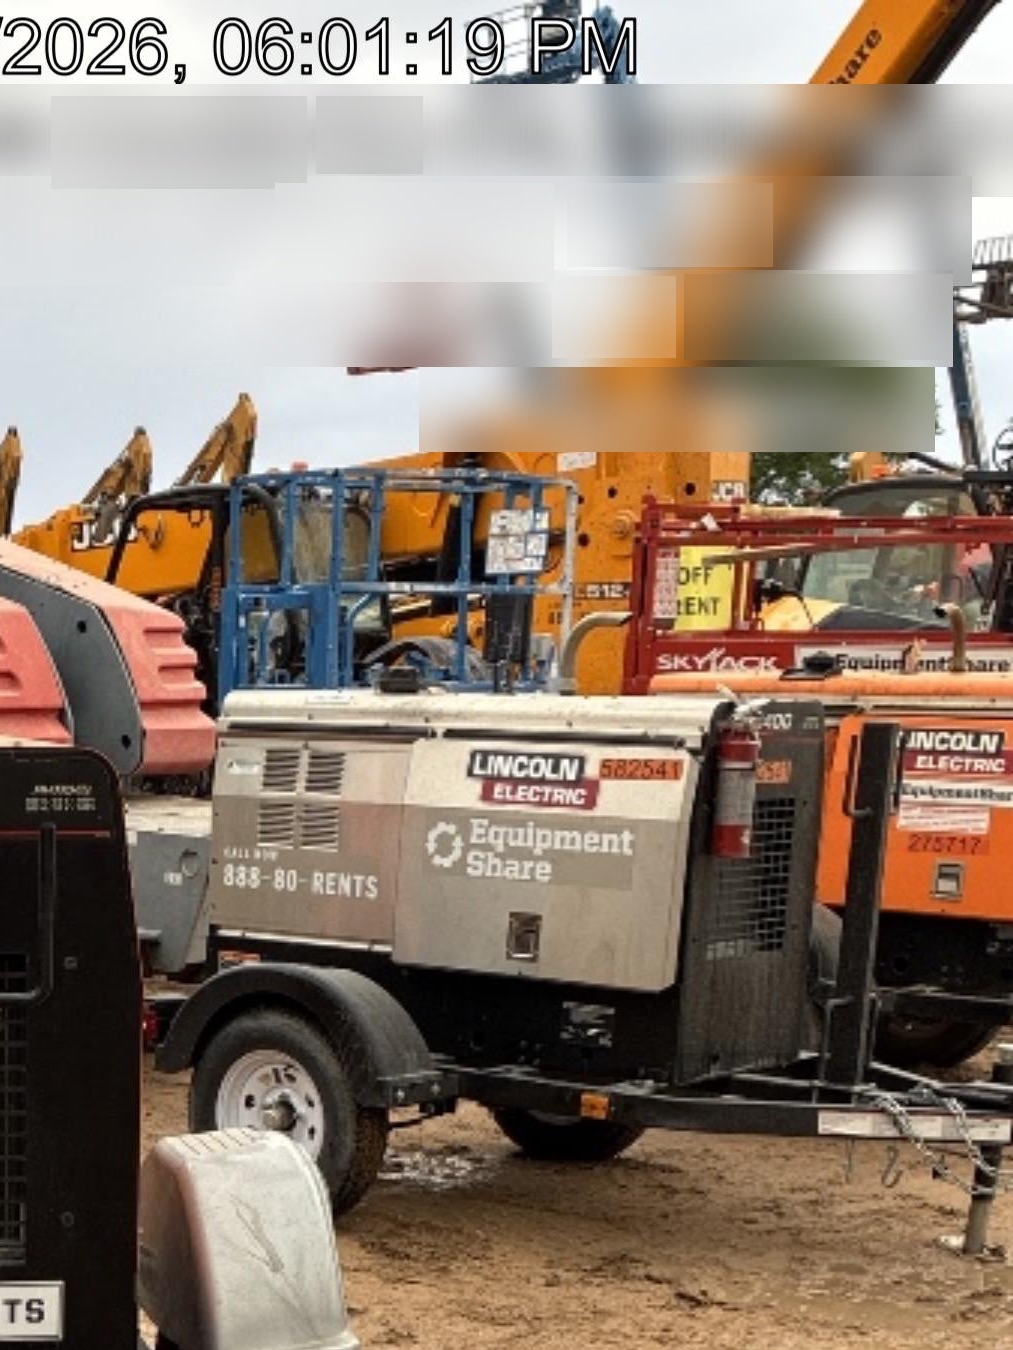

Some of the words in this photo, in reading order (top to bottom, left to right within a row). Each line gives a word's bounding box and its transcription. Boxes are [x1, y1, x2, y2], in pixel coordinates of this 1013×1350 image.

[472, 755, 581, 781] LINCOLN
[914, 754, 1006, 773] ELECTRIC
[492, 783, 588, 806] ELECTRIC
[469, 818, 635, 856] Equipment
[466, 850, 552, 882] Share
